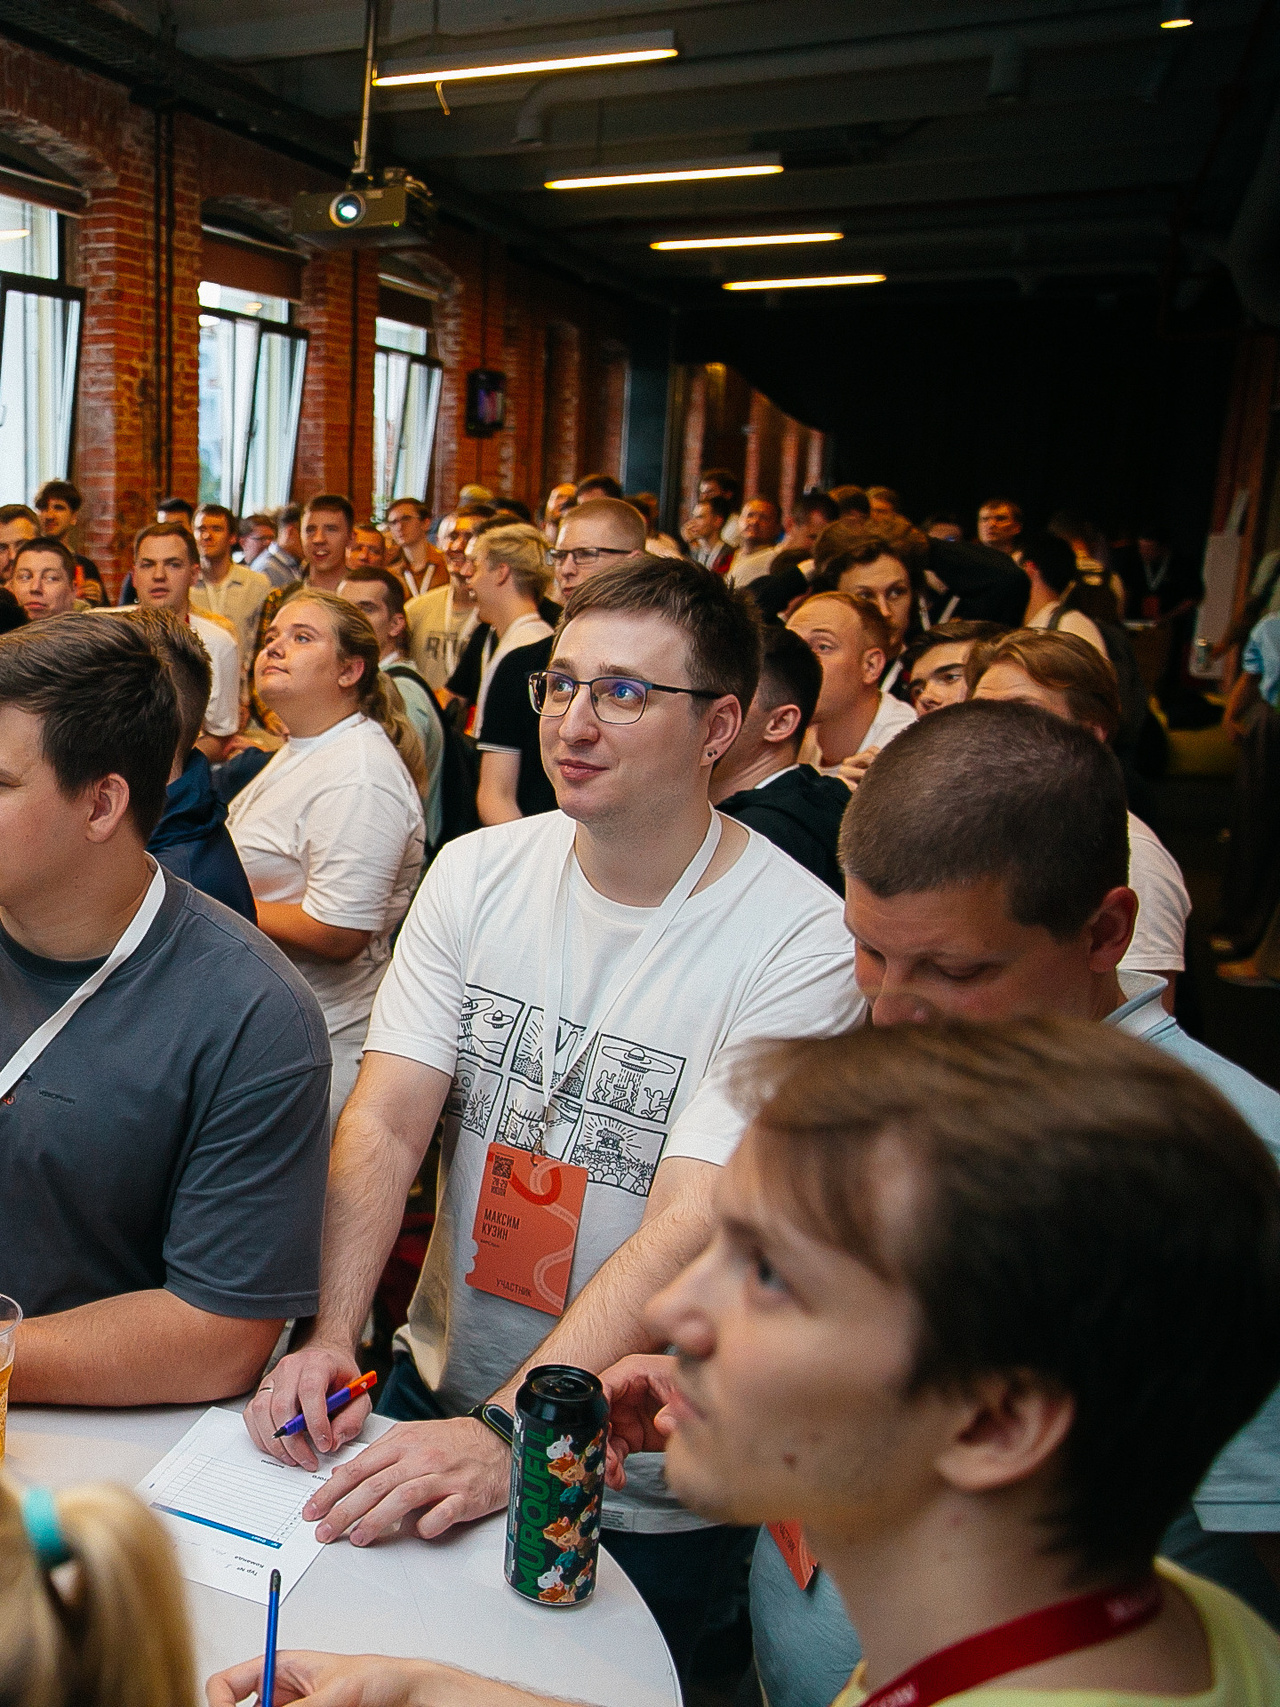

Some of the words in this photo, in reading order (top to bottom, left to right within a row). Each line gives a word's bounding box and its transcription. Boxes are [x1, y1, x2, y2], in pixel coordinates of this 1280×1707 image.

[483, 1208, 520, 1230] МАКСИМ
[481, 1222, 509, 1241] КУЗИН
[495, 1277, 532, 1298] УЧАСТНИК
[517, 1428, 554, 1596] MURQUELL
